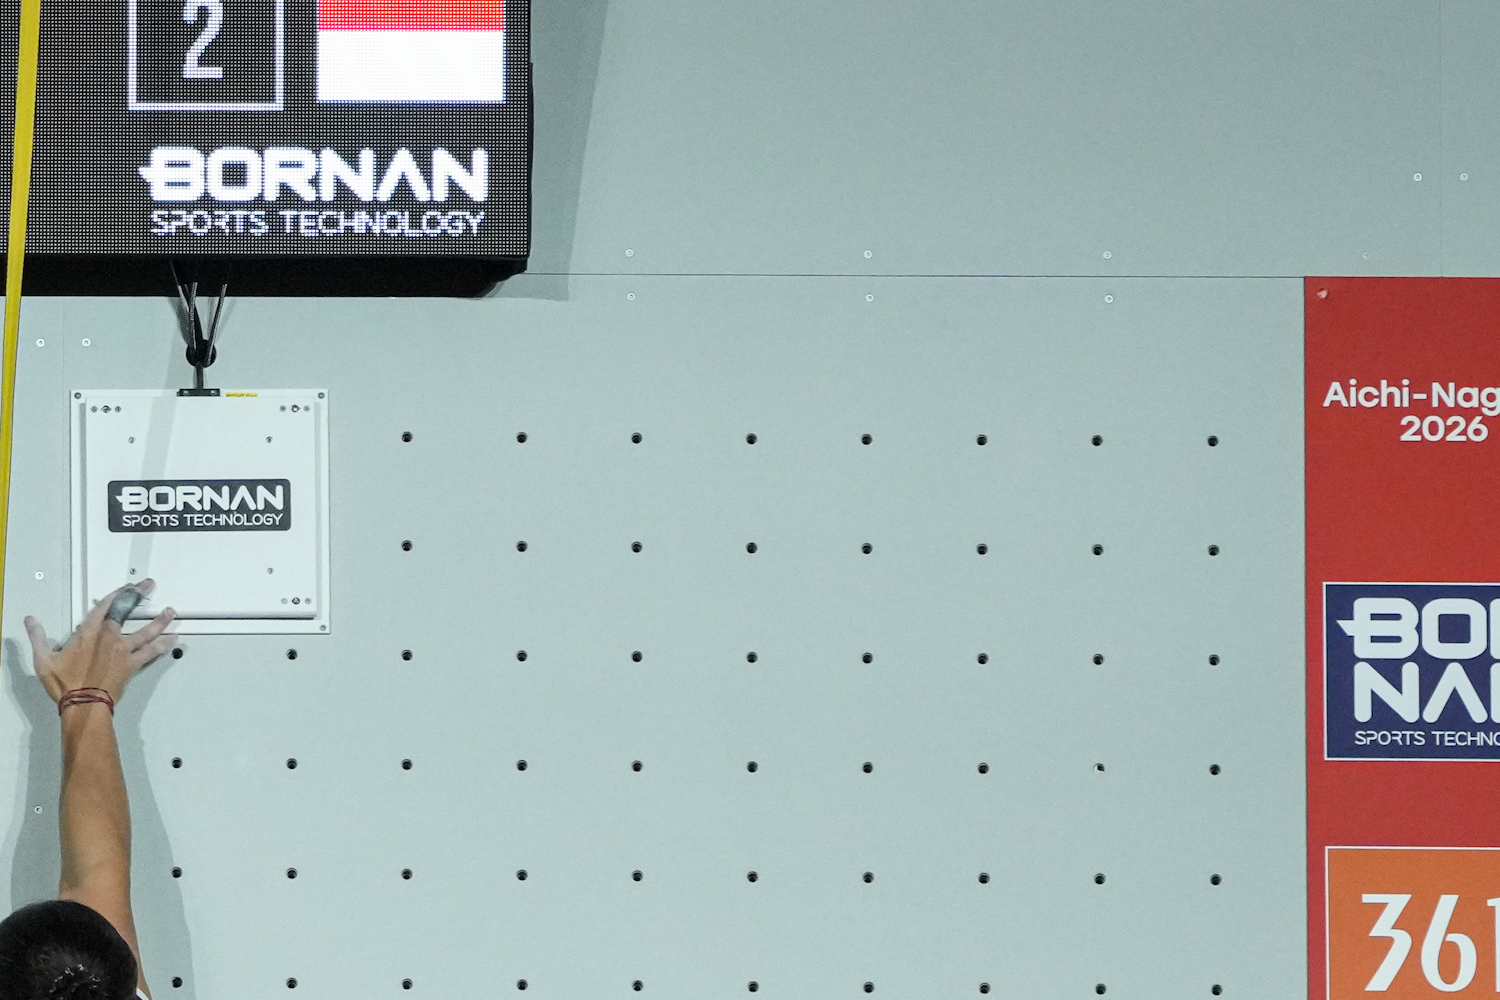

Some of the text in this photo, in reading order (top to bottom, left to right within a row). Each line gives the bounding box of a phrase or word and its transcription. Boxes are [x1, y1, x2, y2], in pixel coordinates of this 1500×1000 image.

[182, 0, 223, 79] 2
[138, 147, 488, 201] BORNAN
[151, 210, 485, 237] SPORTS TECHNOLOGY
[1400, 415, 1489, 442] 2026
[116, 485, 284, 511] BORNAN
[122, 513, 284, 527] SPORTS TECHNOLOGY
[1336, 597, 1500, 660] BO
[1354, 661, 1500, 723] NA
[1354, 730, 1426, 746] SPORTS
